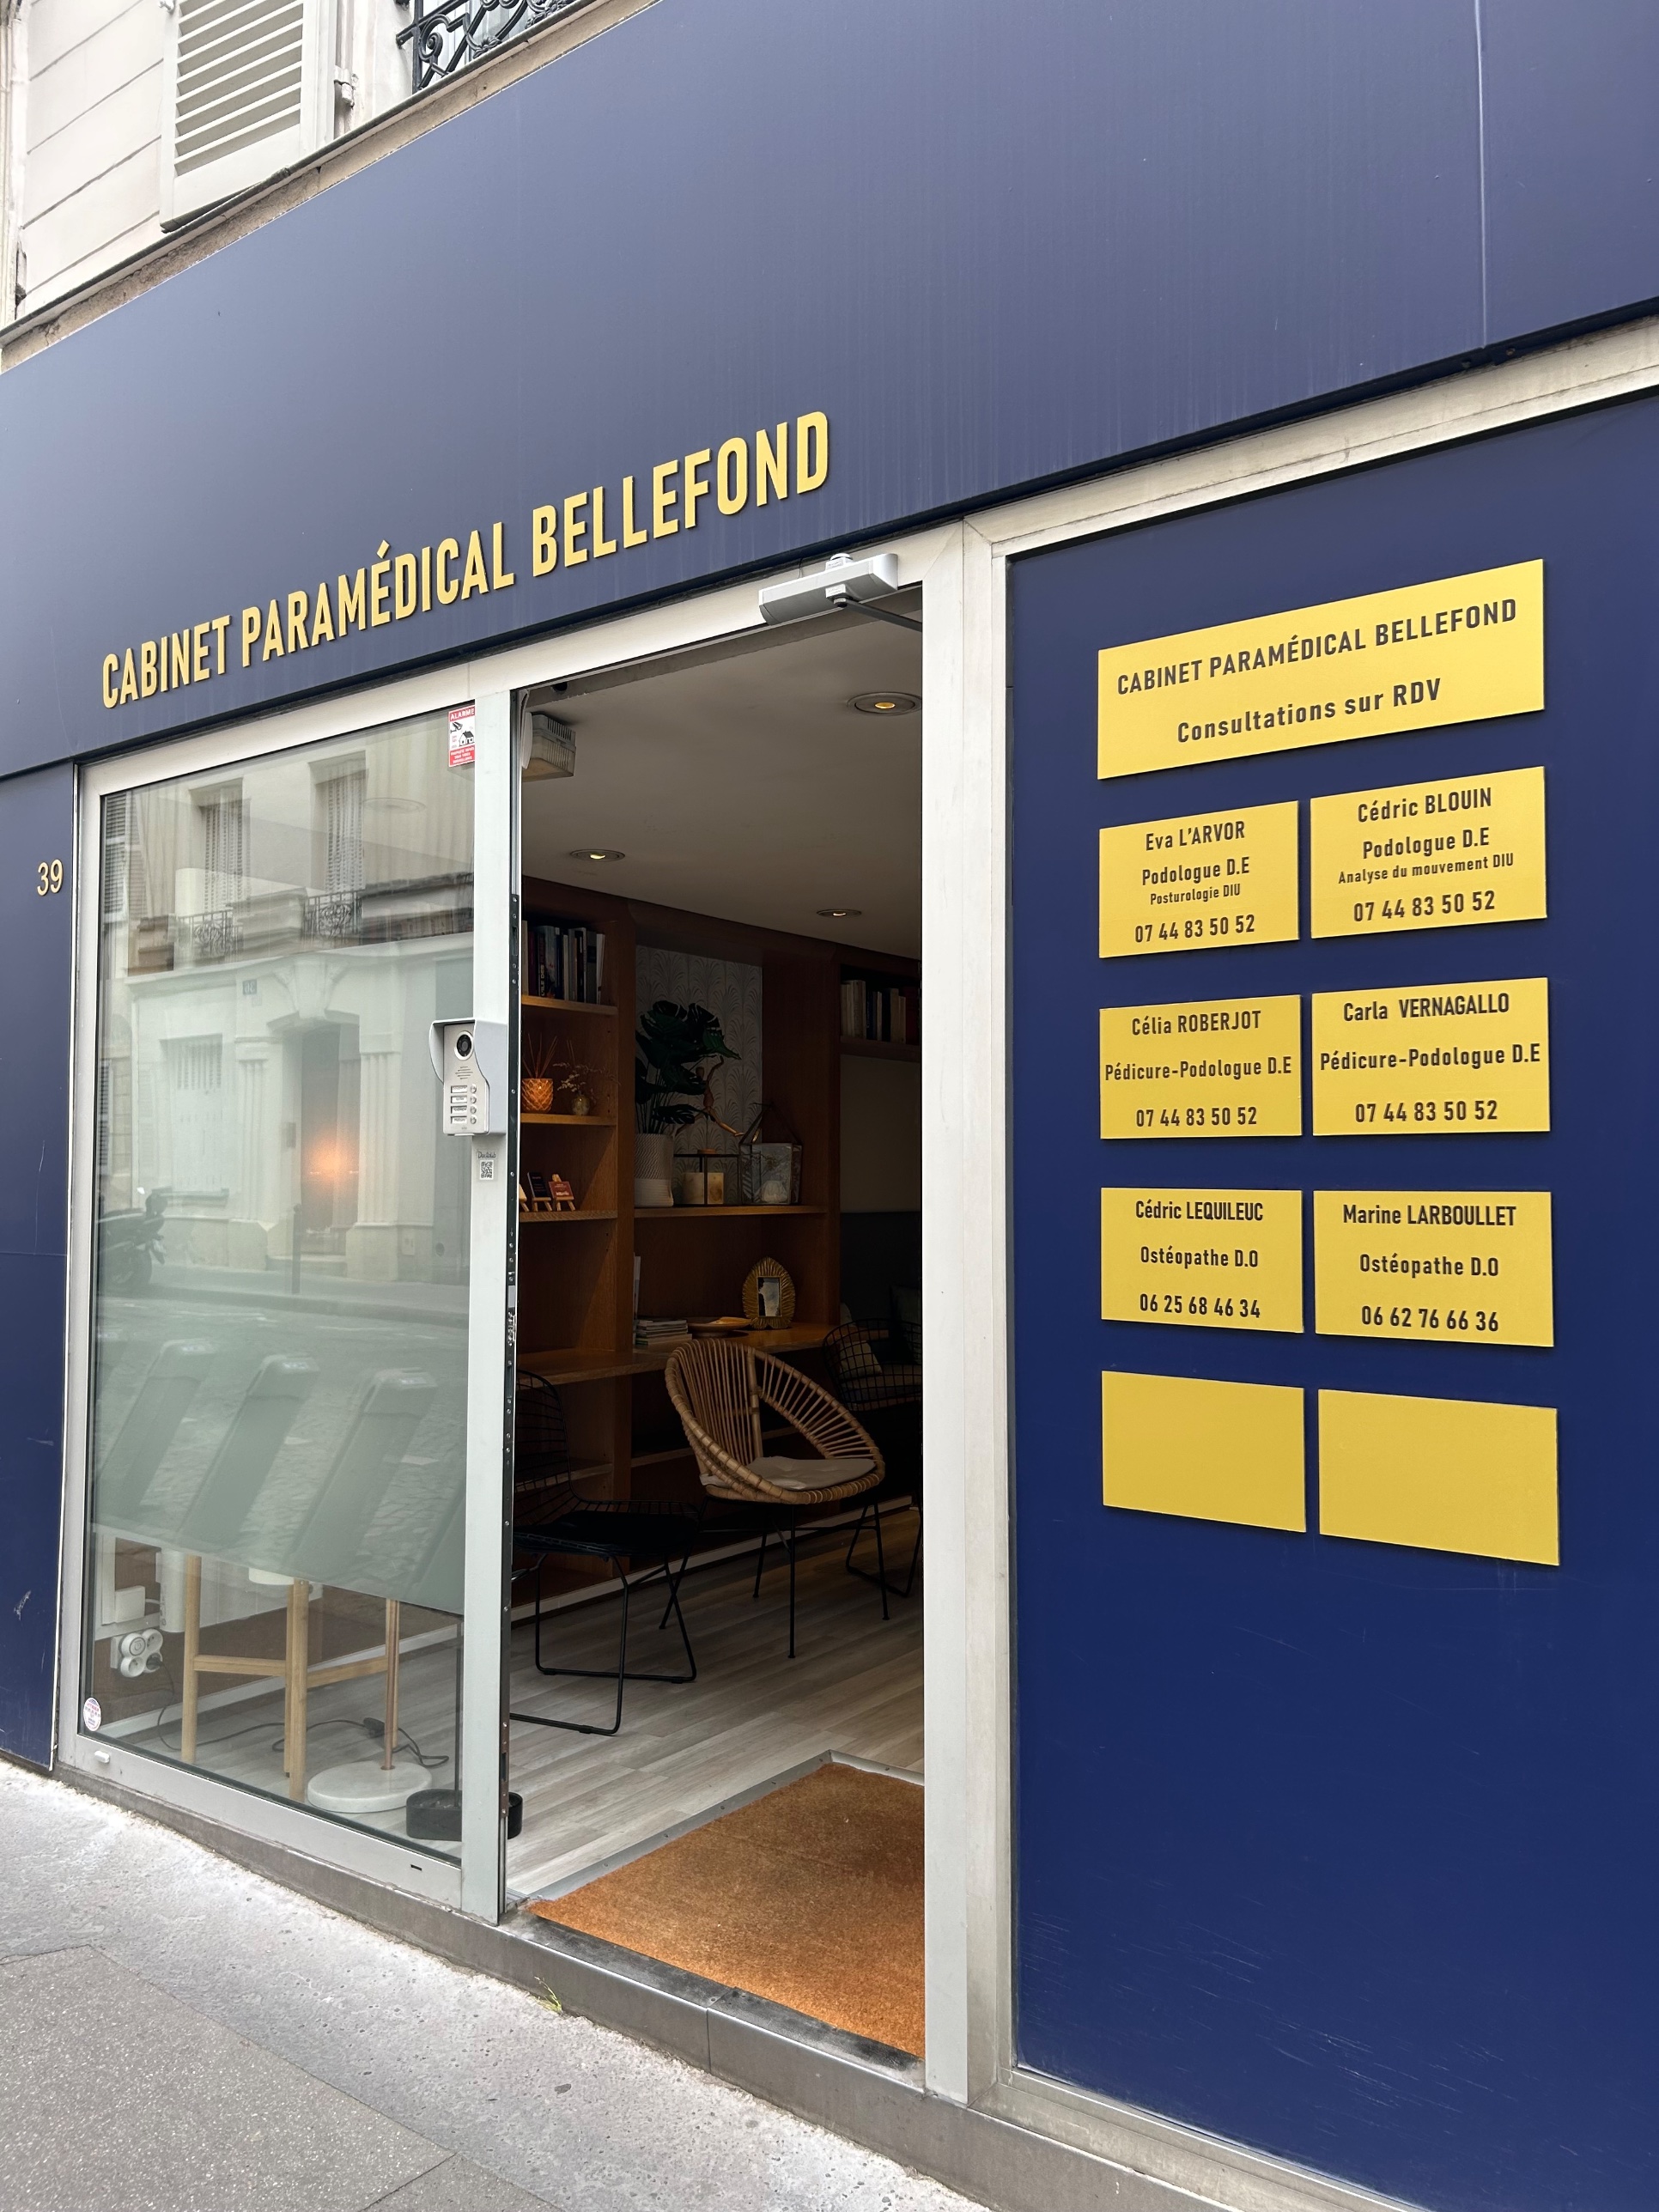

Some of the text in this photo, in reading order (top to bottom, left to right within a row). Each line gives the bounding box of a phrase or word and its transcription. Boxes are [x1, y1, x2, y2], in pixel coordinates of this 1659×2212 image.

[103, 410, 830, 708] CABINET PARAMÉDICAL BELLEFOND
[1117, 599, 1516, 696] CABINET PARAMÉDICAL BELLEFOND
[450, 708, 475, 721] ALARME
[1177, 678, 1441, 743] Consultations sur RDV
[1358, 787, 1492, 823] Cédric BLOUIN
[1146, 820, 1245, 852] Eva L'ARVOR
[1363, 826, 1490, 860] Podologue D.E
[37, 859, 64, 896] 39
[1142, 856, 1250, 886] Podologue D.E
[1338, 852, 1514, 885] Analyse du mouvement DIU
[1150, 883, 1241, 906] Posturologie DIU
[1353, 890, 1495, 922] 07 44 83 50 52
[1134, 914, 1255, 943] 07 44 83 50 52
[1343, 992, 1510, 1022] Carla VERNAGALLO
[1132, 1010, 1261, 1036] Célia ROBERJOT
[1105, 1055, 1291, 1081] Pédicure-Podologue D.E
[1320, 1042, 1540, 1071] Pédicure-Podologue D.E
[1136, 1106, 1257, 1127] 07 44 83 50 52
[1355, 1099, 1498, 1123] 07 44 83 50 52
[1135, 1198, 1264, 1222] Cédric LEQUILEUC
[1343, 1204, 1517, 1226] Marine LARBOULLET
[1140, 1244, 1259, 1270] Ostéopathe D.O
[1359, 1252, 1499, 1279] Ostéopathe D.O
[1139, 1293, 1261, 1319] 06 25 68 46 34
[1361, 1305, 1499, 1333] 06 62 76 66 36
